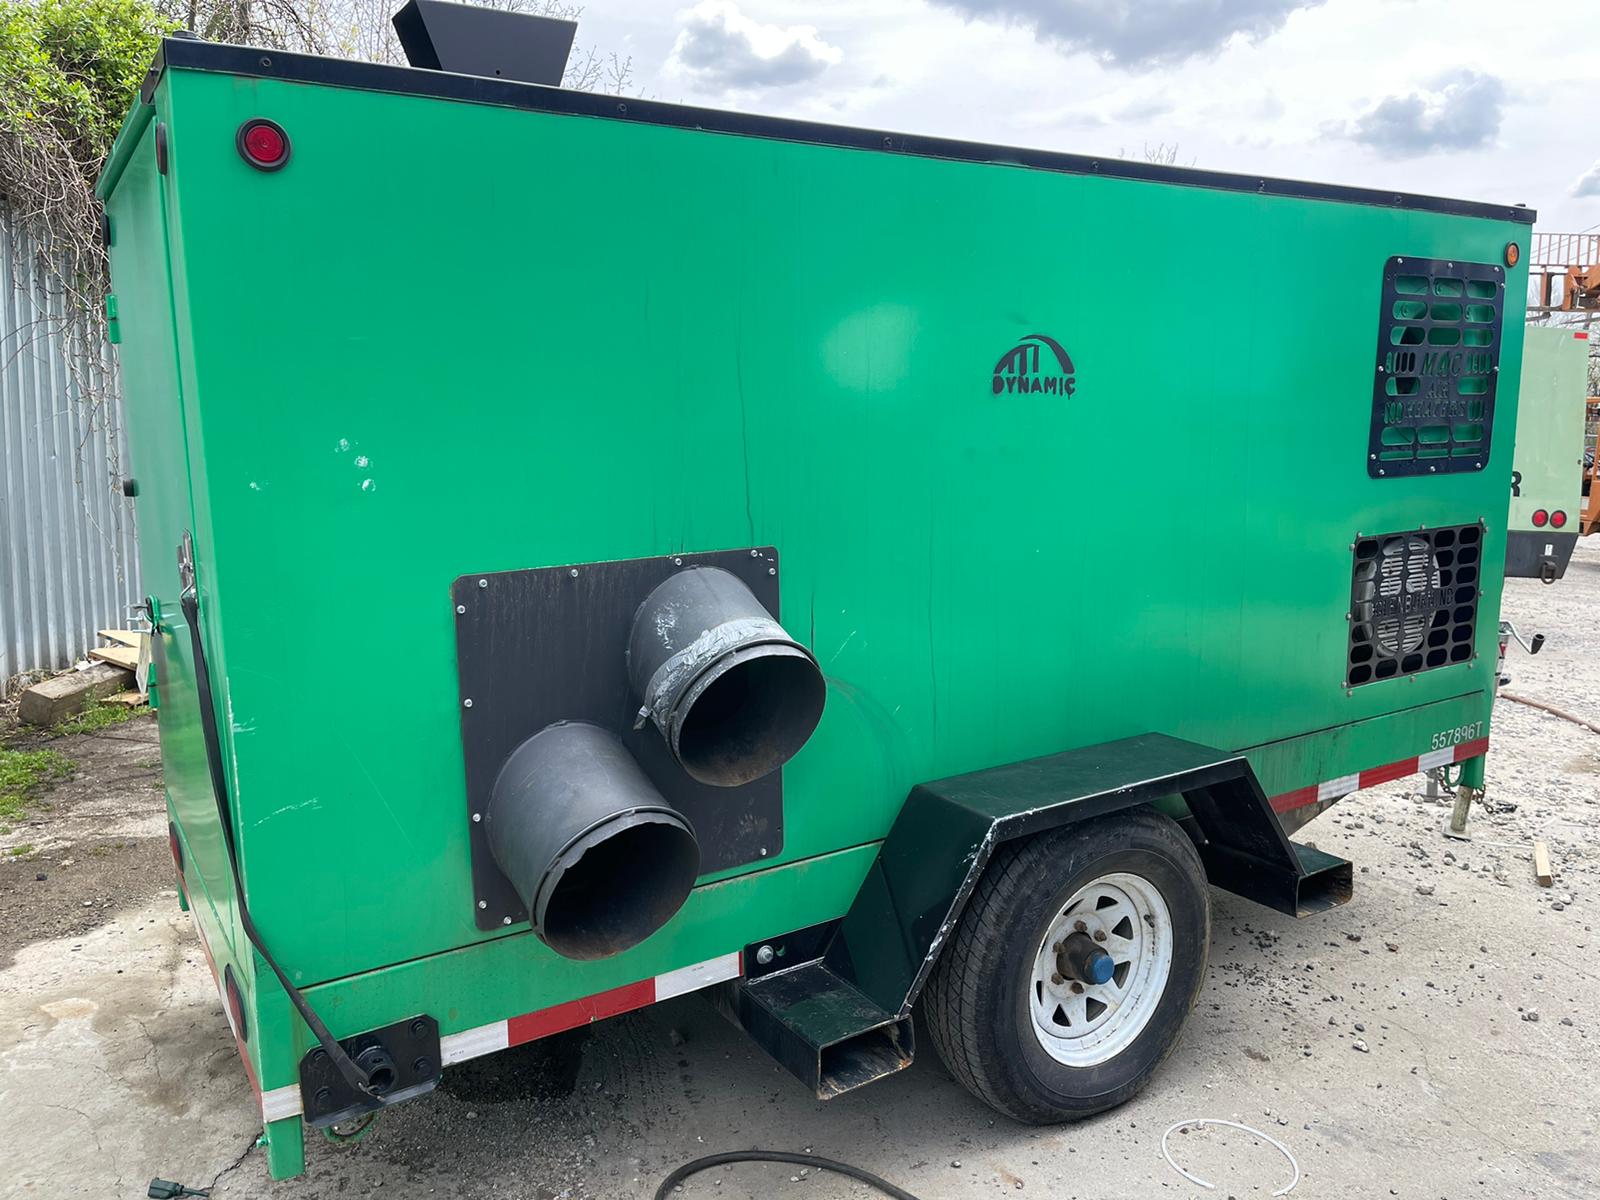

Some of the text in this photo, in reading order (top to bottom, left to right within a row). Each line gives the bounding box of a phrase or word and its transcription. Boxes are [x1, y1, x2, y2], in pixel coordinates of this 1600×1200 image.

[1420, 351, 1463, 376] MAC
[993, 376, 1075, 398] DYNAMIC
[1425, 381, 1449, 398] AIR
[1405, 400, 1466, 418] HEATERS
[1431, 721, 1482, 750] 557896T
